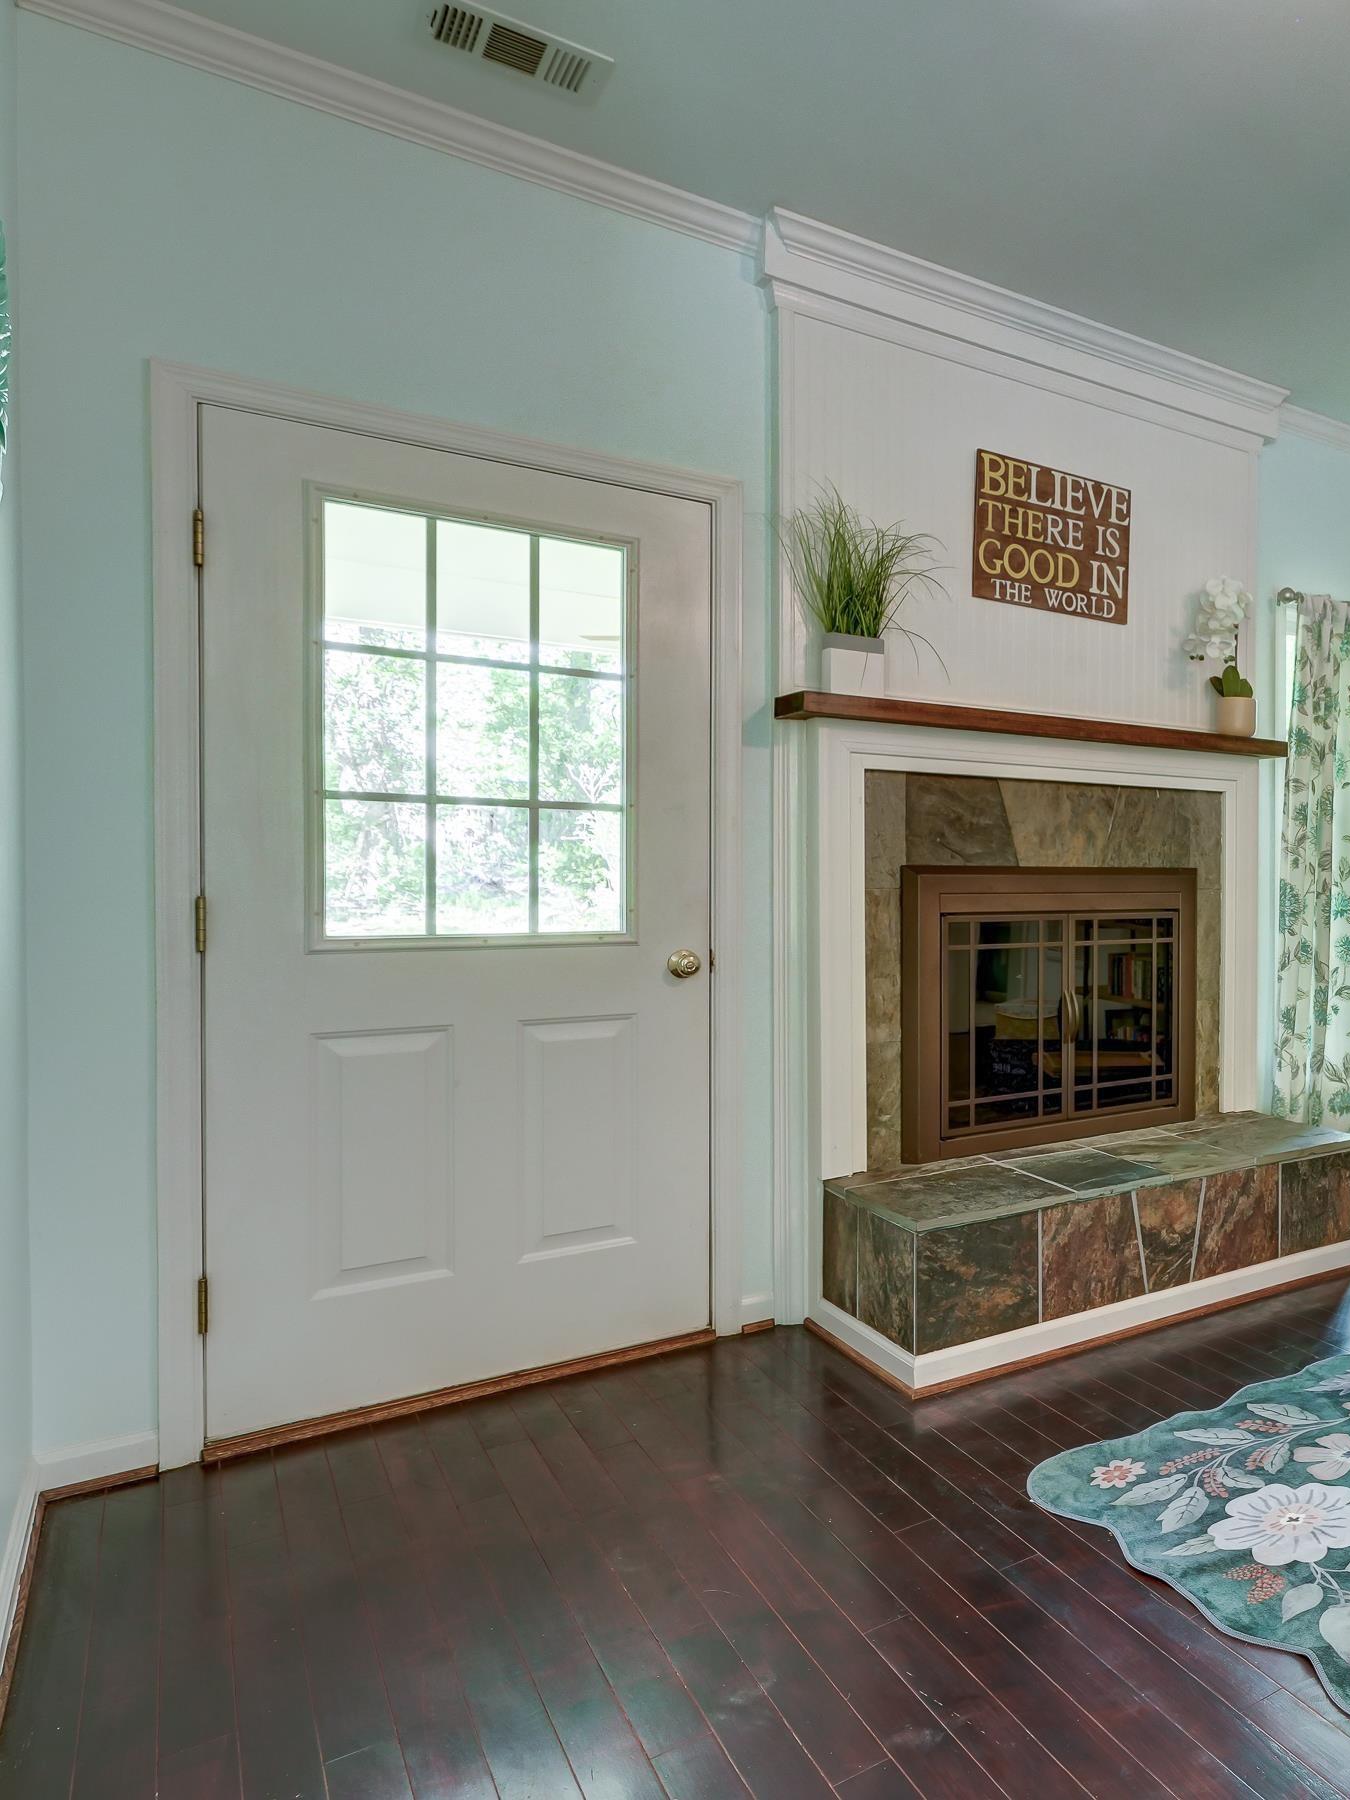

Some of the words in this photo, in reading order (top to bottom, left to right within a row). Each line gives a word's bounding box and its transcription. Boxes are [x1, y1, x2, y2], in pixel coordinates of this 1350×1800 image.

[981, 452, 1129, 526] BELIEVE
[979, 498, 1084, 551] THERE
[1096, 525, 1120, 558] IS
[978, 538, 1080, 588] GOOD
[1089, 560, 1126, 599] IN
[991, 578, 1032, 604] THE
[1044, 588, 1116, 618] WORLD
